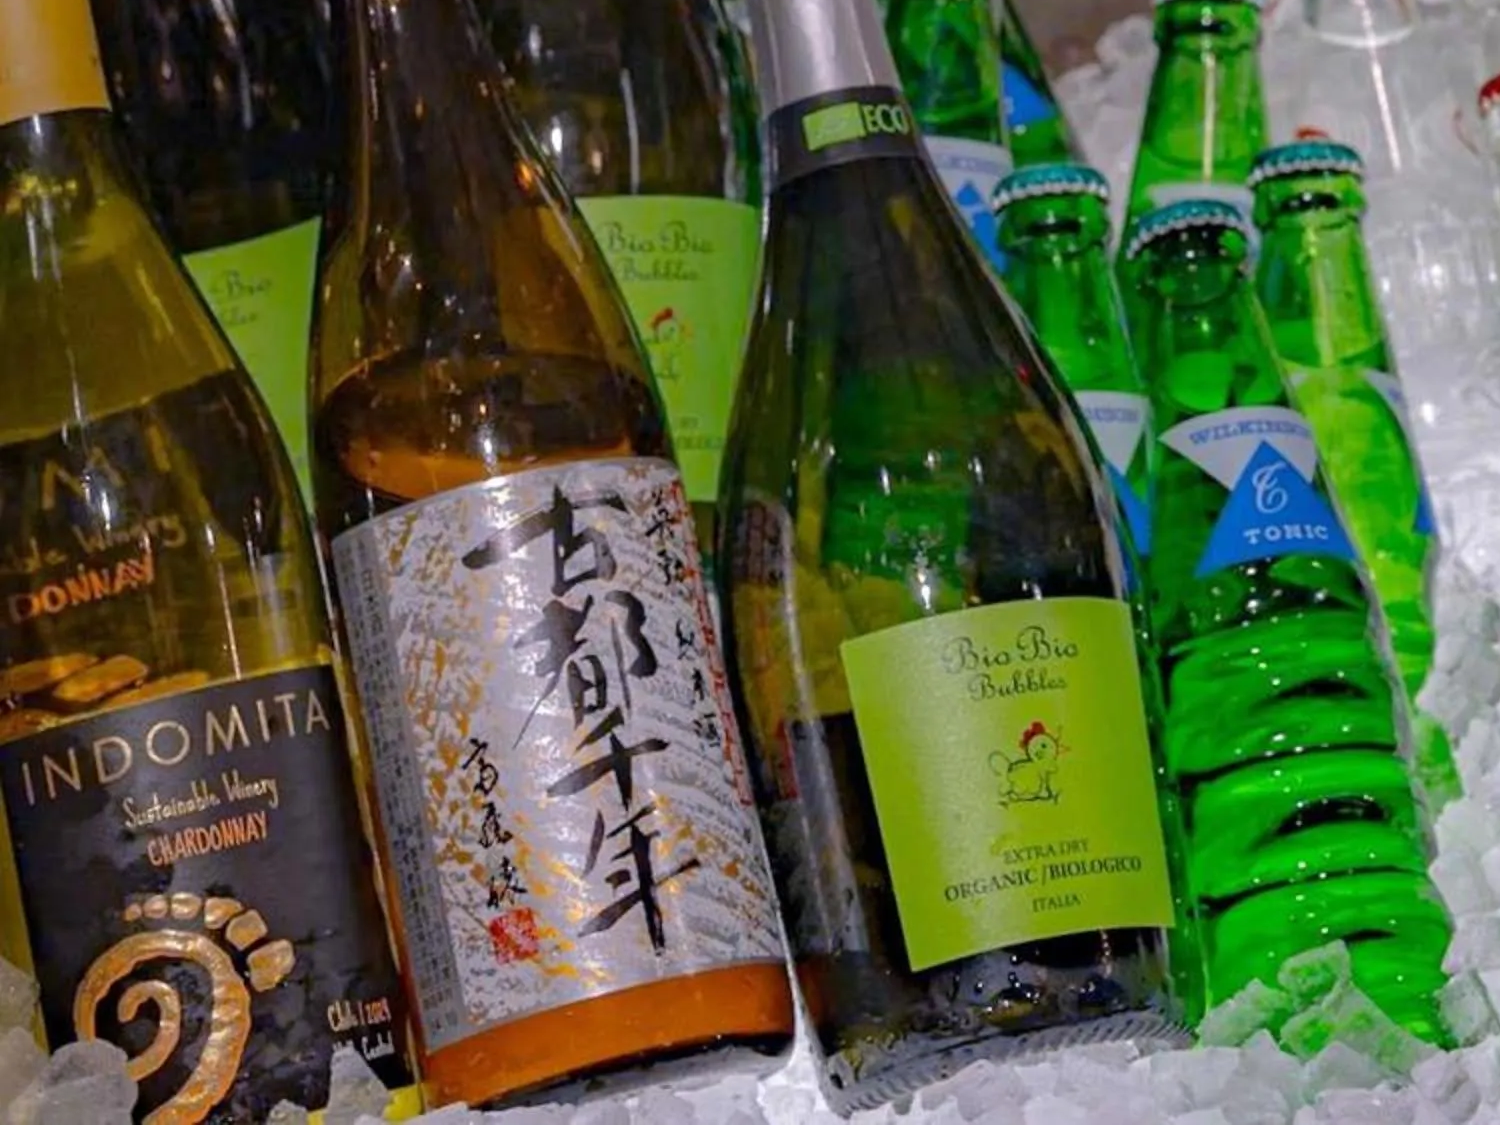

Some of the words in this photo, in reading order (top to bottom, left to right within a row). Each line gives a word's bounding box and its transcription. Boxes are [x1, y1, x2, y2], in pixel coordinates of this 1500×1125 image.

[864, 104, 910, 133] ECO
[1242, 523, 1330, 545] TONIC
[944, 635, 1012, 675] Bio
[1016, 625, 1080, 663] Bio
[969, 673, 1068, 703] Bubbles
[21, 687, 331, 807] INDOMITA
[122, 776, 222, 829] Sustainable
[225, 769, 278, 808] Winery
[146, 811, 269, 868] CHARDONNAY
[1003, 844, 1056, 865] EXTRA
[1058, 839, 1090, 856] DRY
[1032, 893, 1082, 913] ITALIA
